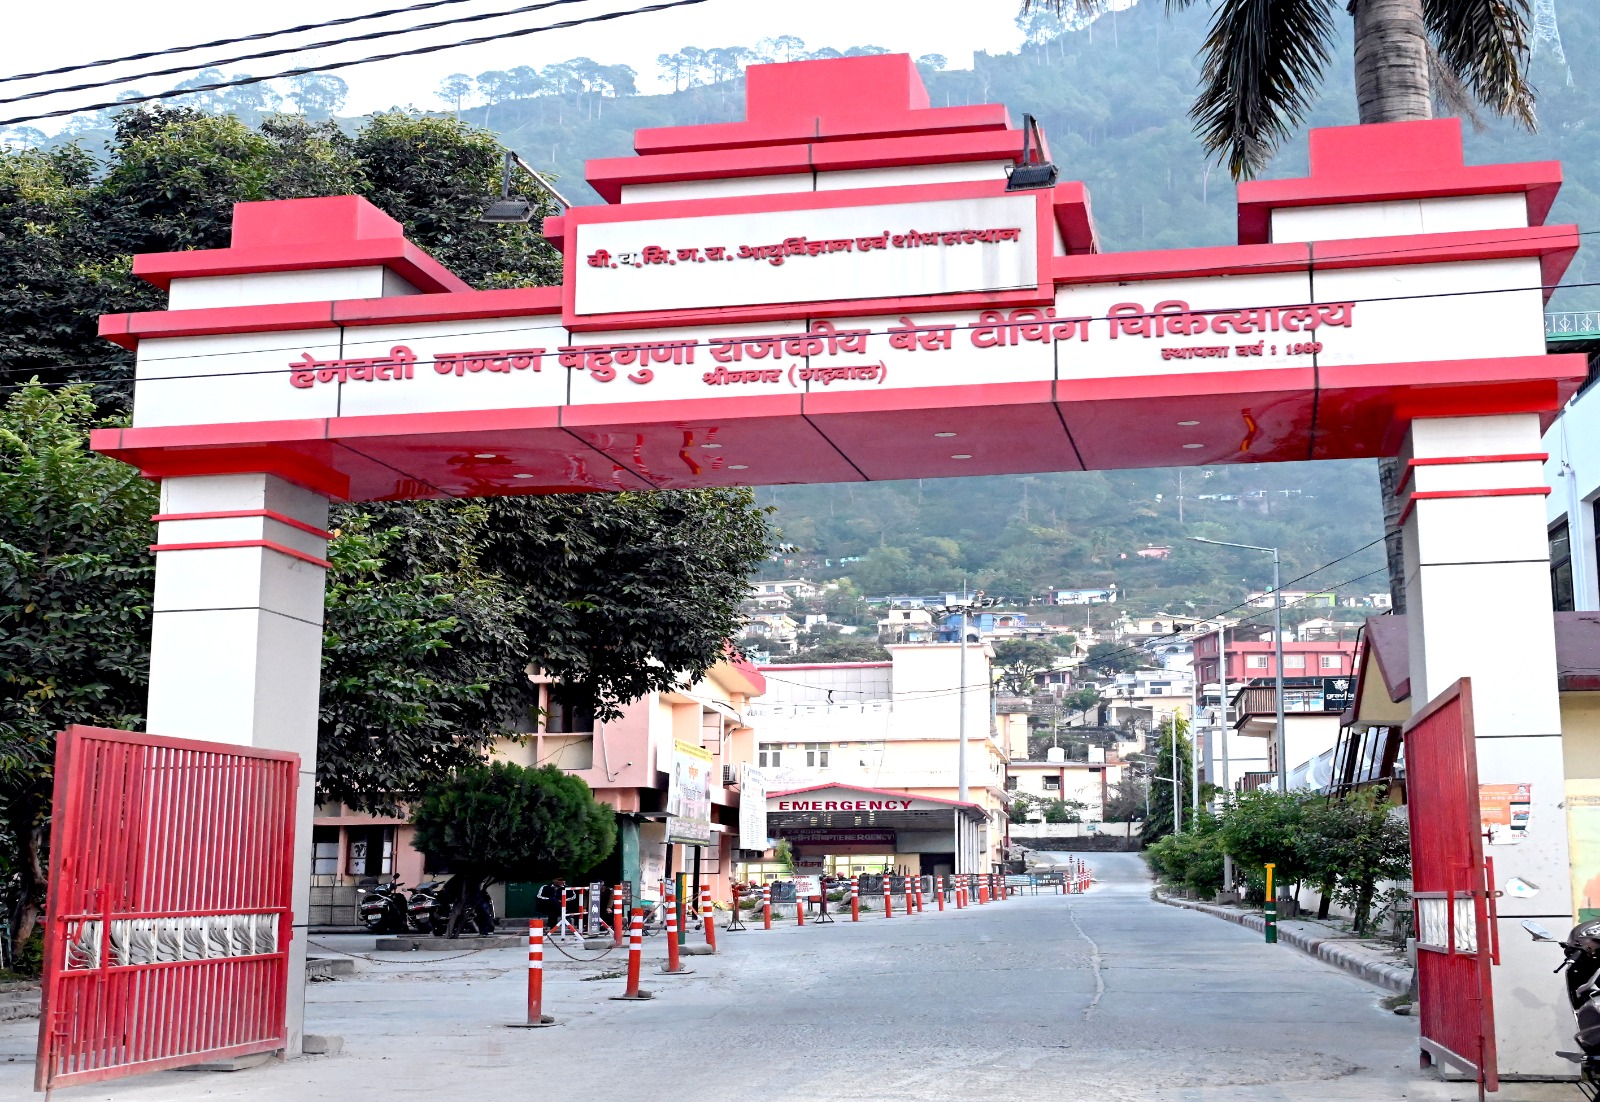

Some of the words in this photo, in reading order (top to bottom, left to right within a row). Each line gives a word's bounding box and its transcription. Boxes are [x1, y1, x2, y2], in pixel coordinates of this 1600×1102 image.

[737, 236, 854, 266] आयुर्विज्ञान
[856, 230, 890, 252] एवं
[892, 229, 939, 248] शोध
[288, 345, 417, 389] हेमवती
[433, 348, 546, 377] नन्दन
[558, 339, 698, 384] बहुगुणा
[708, 320, 870, 363] राजकीय
[887, 317, 956, 351] बेस
[968, 307, 1092, 349] टीचिंग
[1106, 300, 1355, 339] चिकित्सालय
[1161, 345, 1230, 361] स्थापना
[1235, 340, 1264, 357] वर्ष
[1286, 341, 1323, 356] 1989
[702, 365, 783, 386] श्रीनगर
[787, 360, 887, 387] (गढ़वाल)
[779, 800, 913, 811] EMERGENCY
